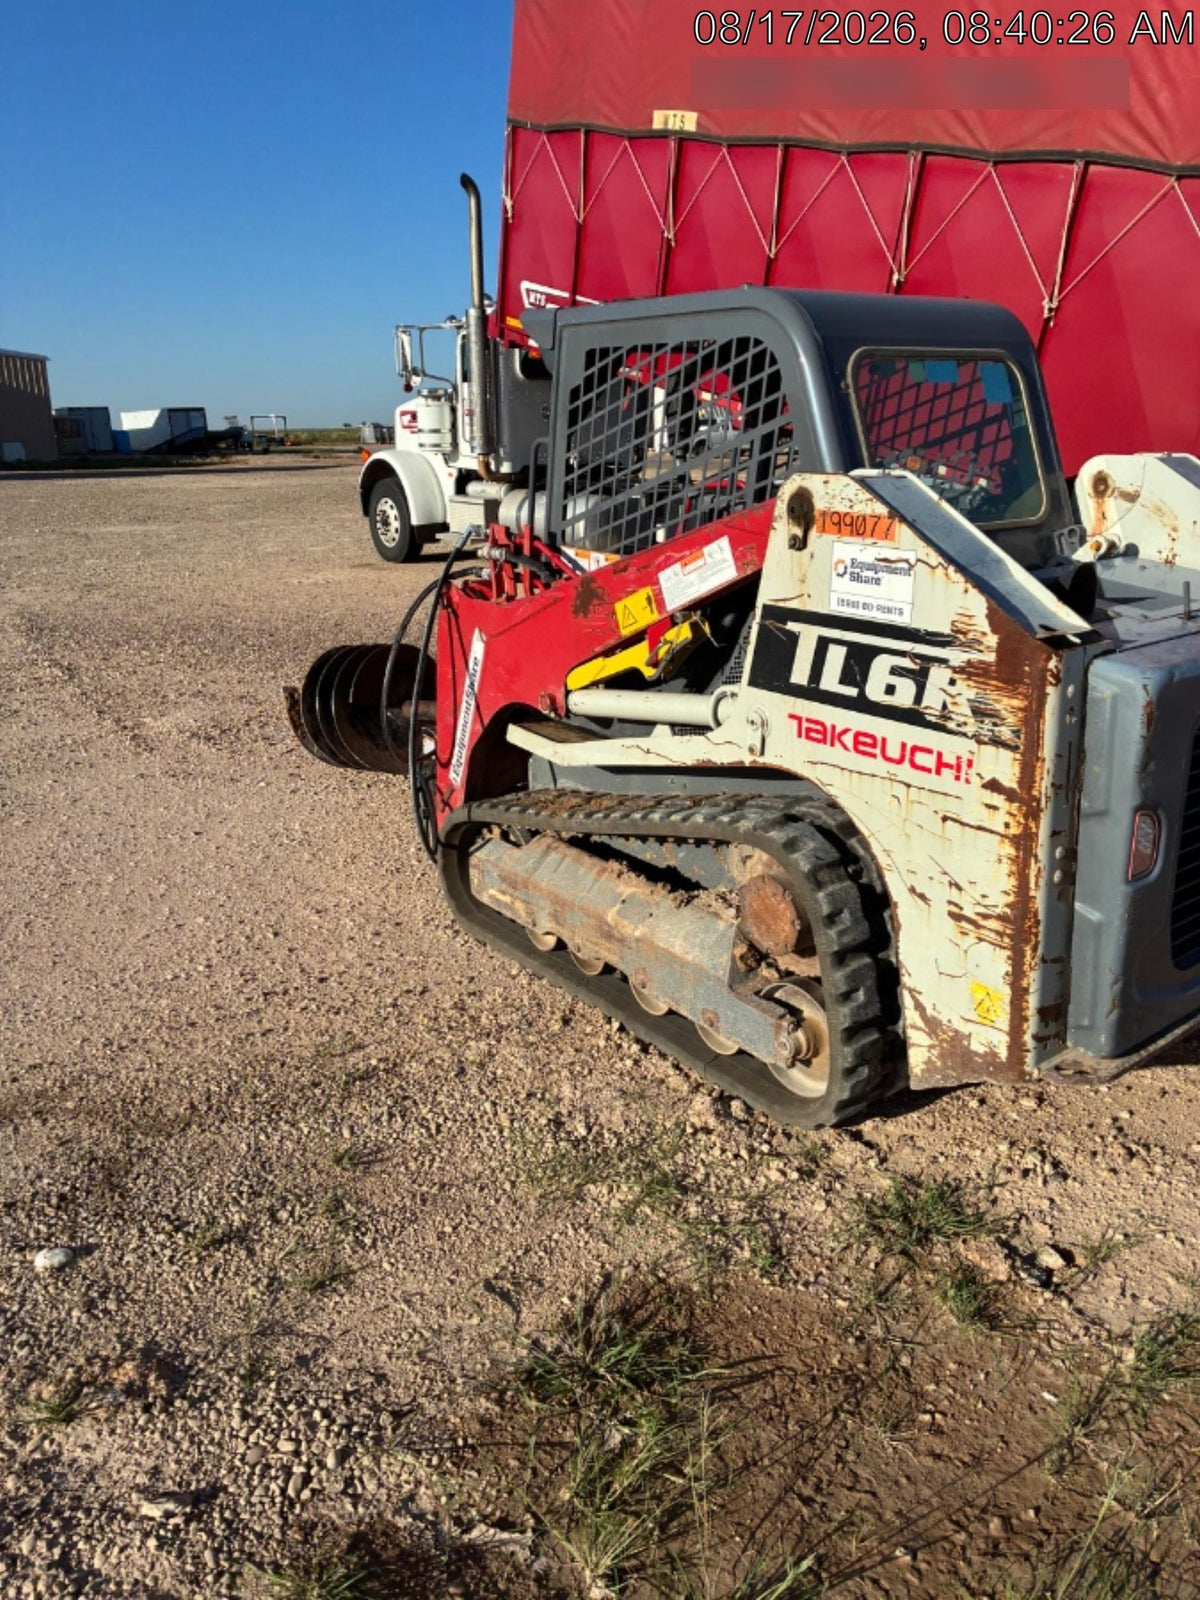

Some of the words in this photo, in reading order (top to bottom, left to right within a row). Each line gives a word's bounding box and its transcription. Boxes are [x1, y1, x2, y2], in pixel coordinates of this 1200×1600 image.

[820, 510, 896, 539] 199077
[849, 558, 911, 577] Equipment
[849, 571, 881, 586] Share
